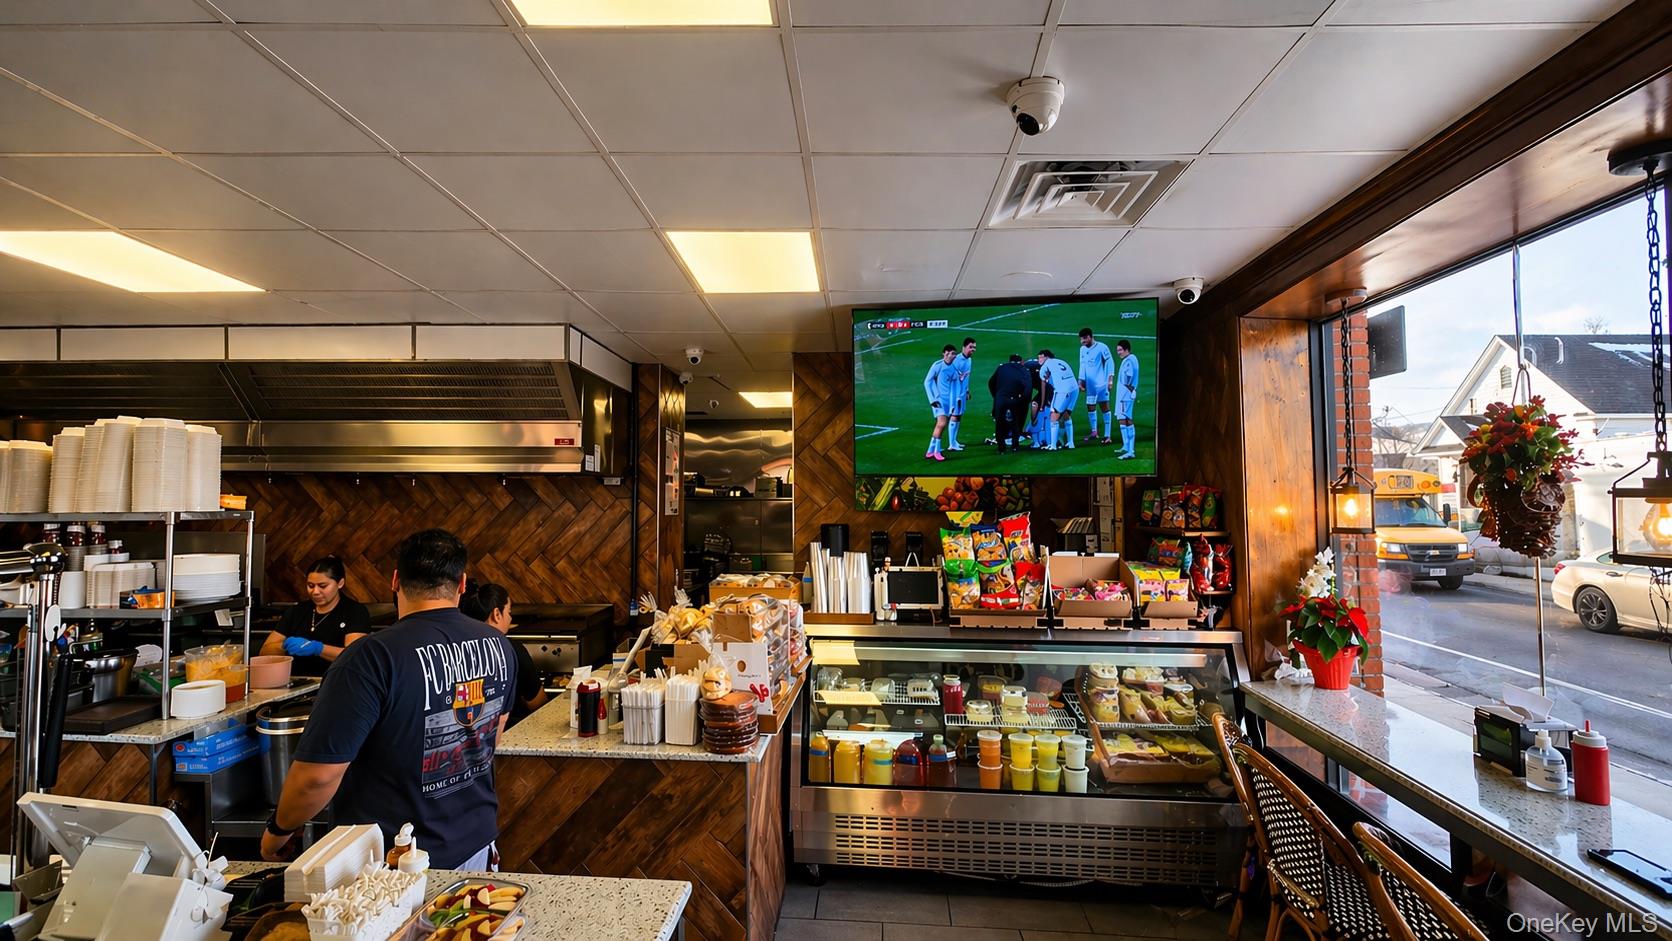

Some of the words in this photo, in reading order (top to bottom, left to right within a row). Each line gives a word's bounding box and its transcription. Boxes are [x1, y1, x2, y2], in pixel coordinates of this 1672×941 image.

[416, 644, 443, 711] FC
[436, 637, 508, 692] BARCELONA
[422, 779, 448, 793] HOME
